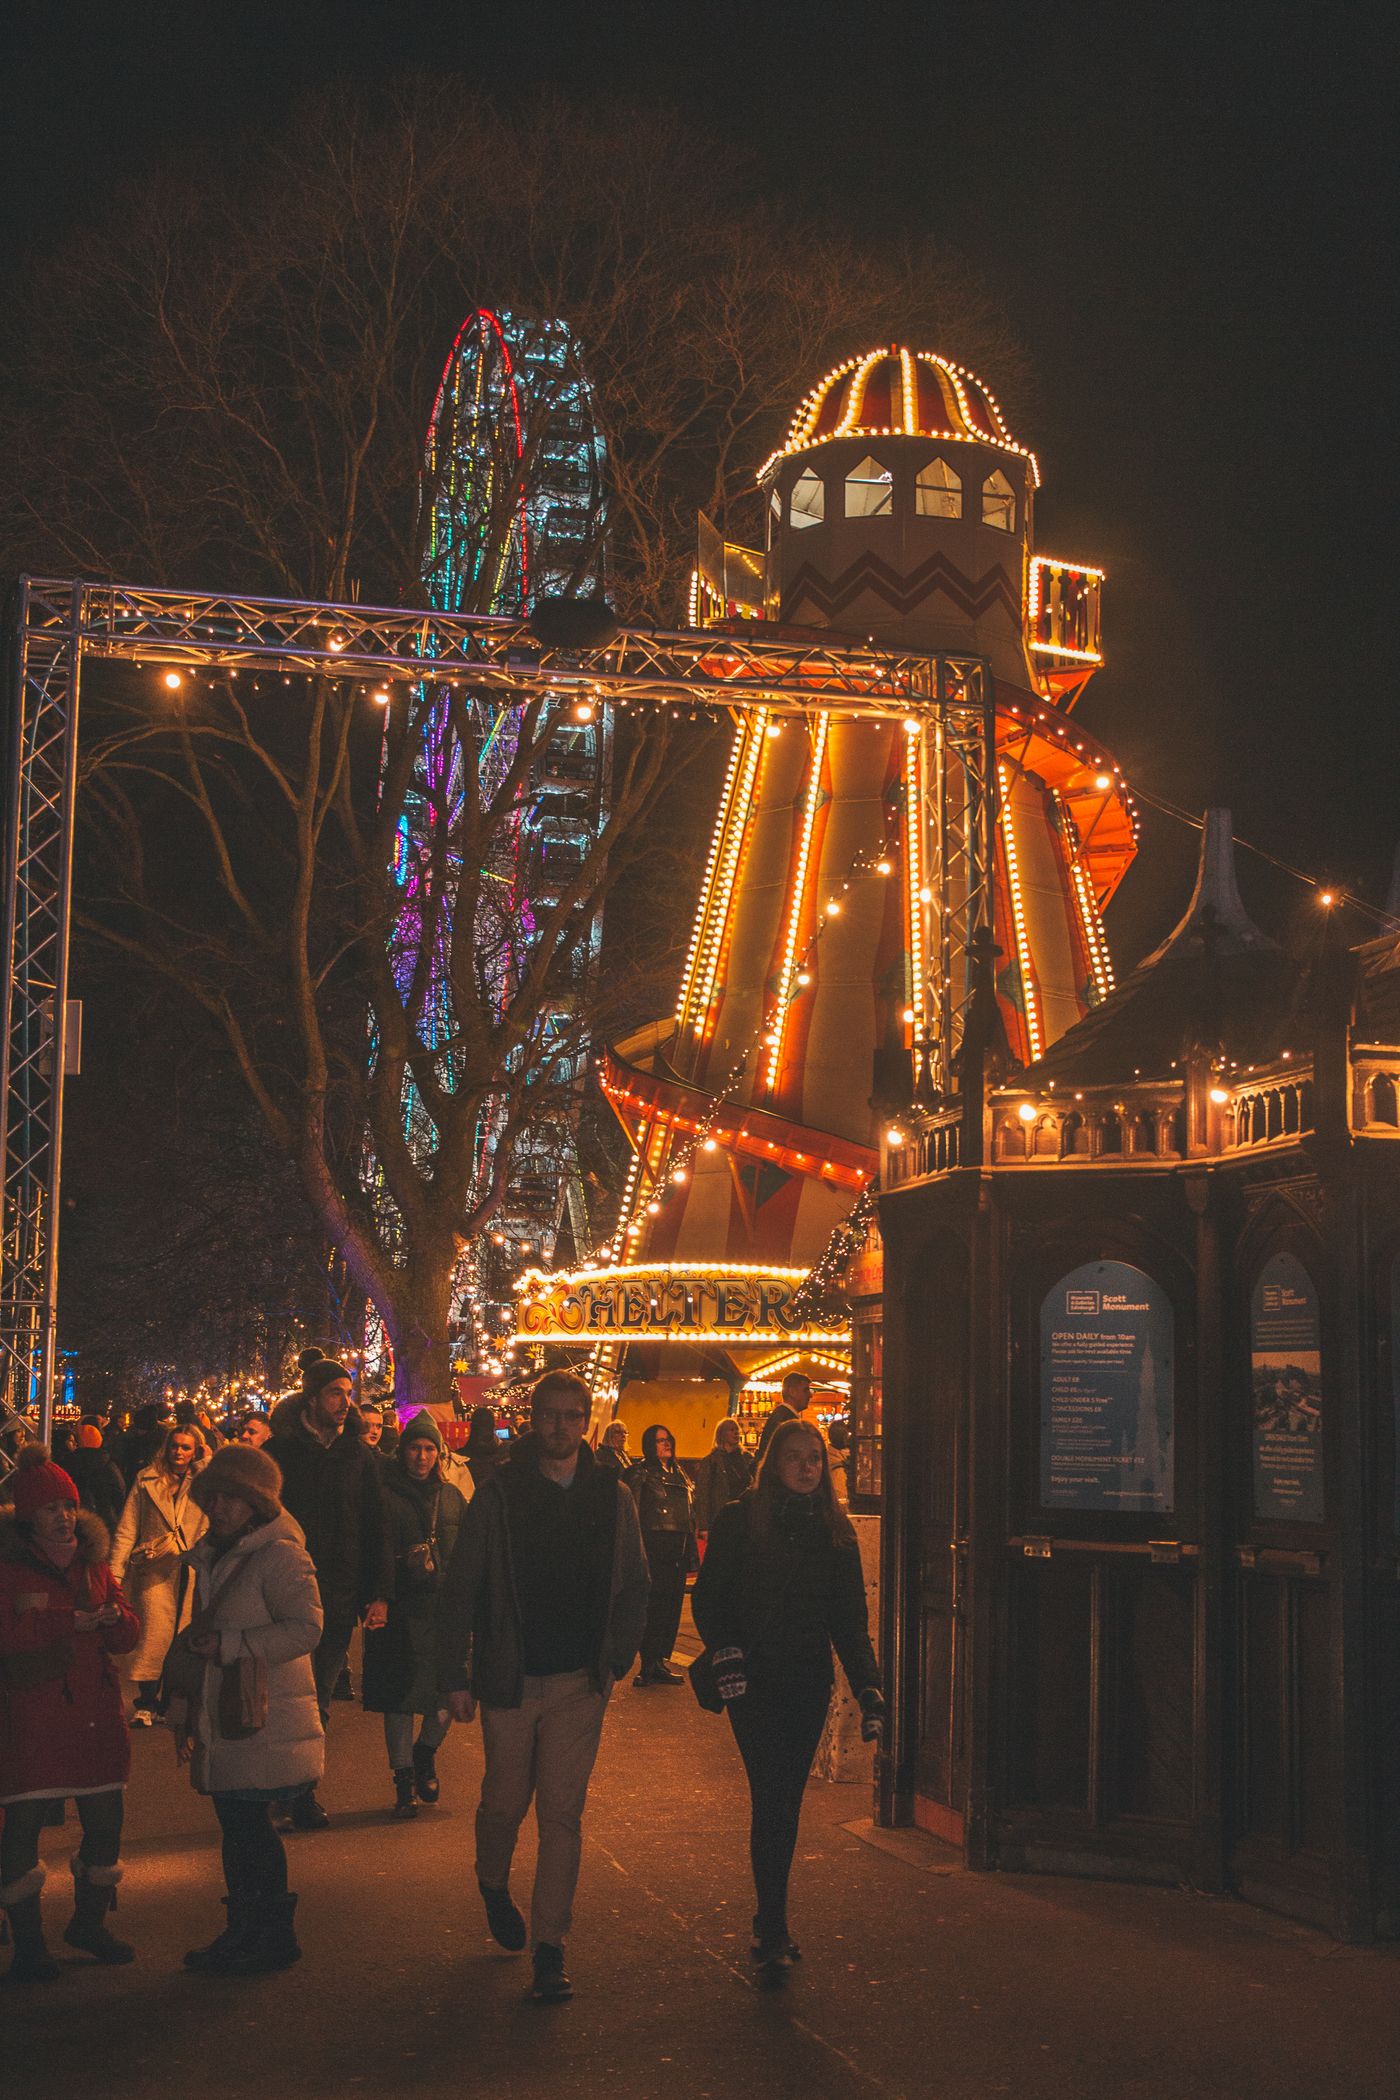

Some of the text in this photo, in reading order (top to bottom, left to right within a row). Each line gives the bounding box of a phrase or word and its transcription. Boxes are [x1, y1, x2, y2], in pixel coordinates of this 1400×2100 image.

[1102, 1295, 1127, 1303] Scott
[577, 1278, 804, 1329] HELTER
[1102, 1303, 1150, 1311] Monument
[1051, 1332, 1075, 1340] OPEN
[1076, 1332, 1100, 1340] DAILY
[1074, 1455, 1112, 1463] MONUMENT
[1051, 1475, 1067, 1484] Enjoy
